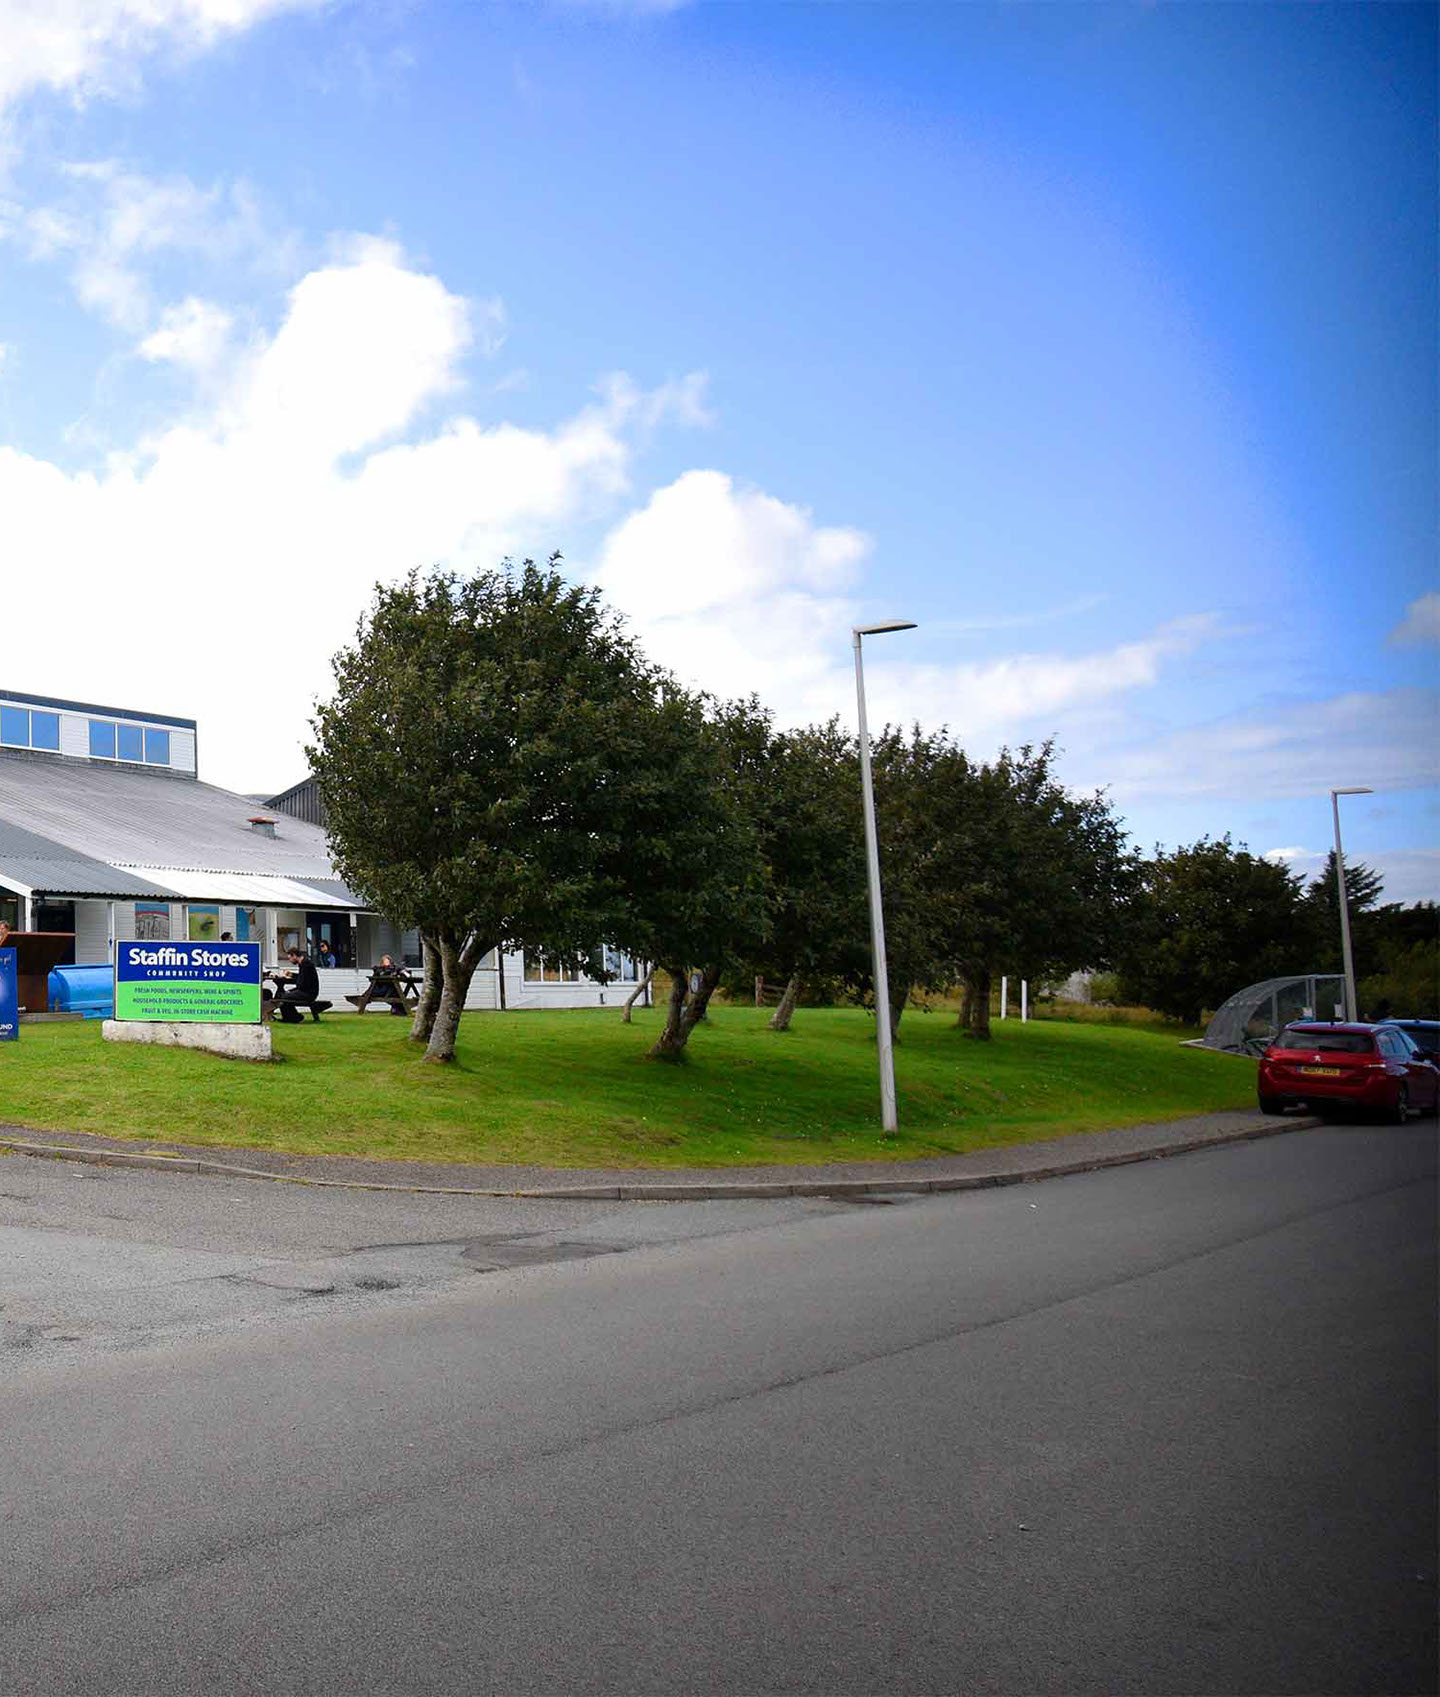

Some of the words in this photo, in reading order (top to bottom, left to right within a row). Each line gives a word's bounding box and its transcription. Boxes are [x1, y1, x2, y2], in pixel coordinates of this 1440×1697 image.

[128, 947, 189, 966] Staffin
[191, 949, 249, 967] Stores
[146, 969, 199, 977] COMMUNITY
[203, 970, 226, 978] SHOP
